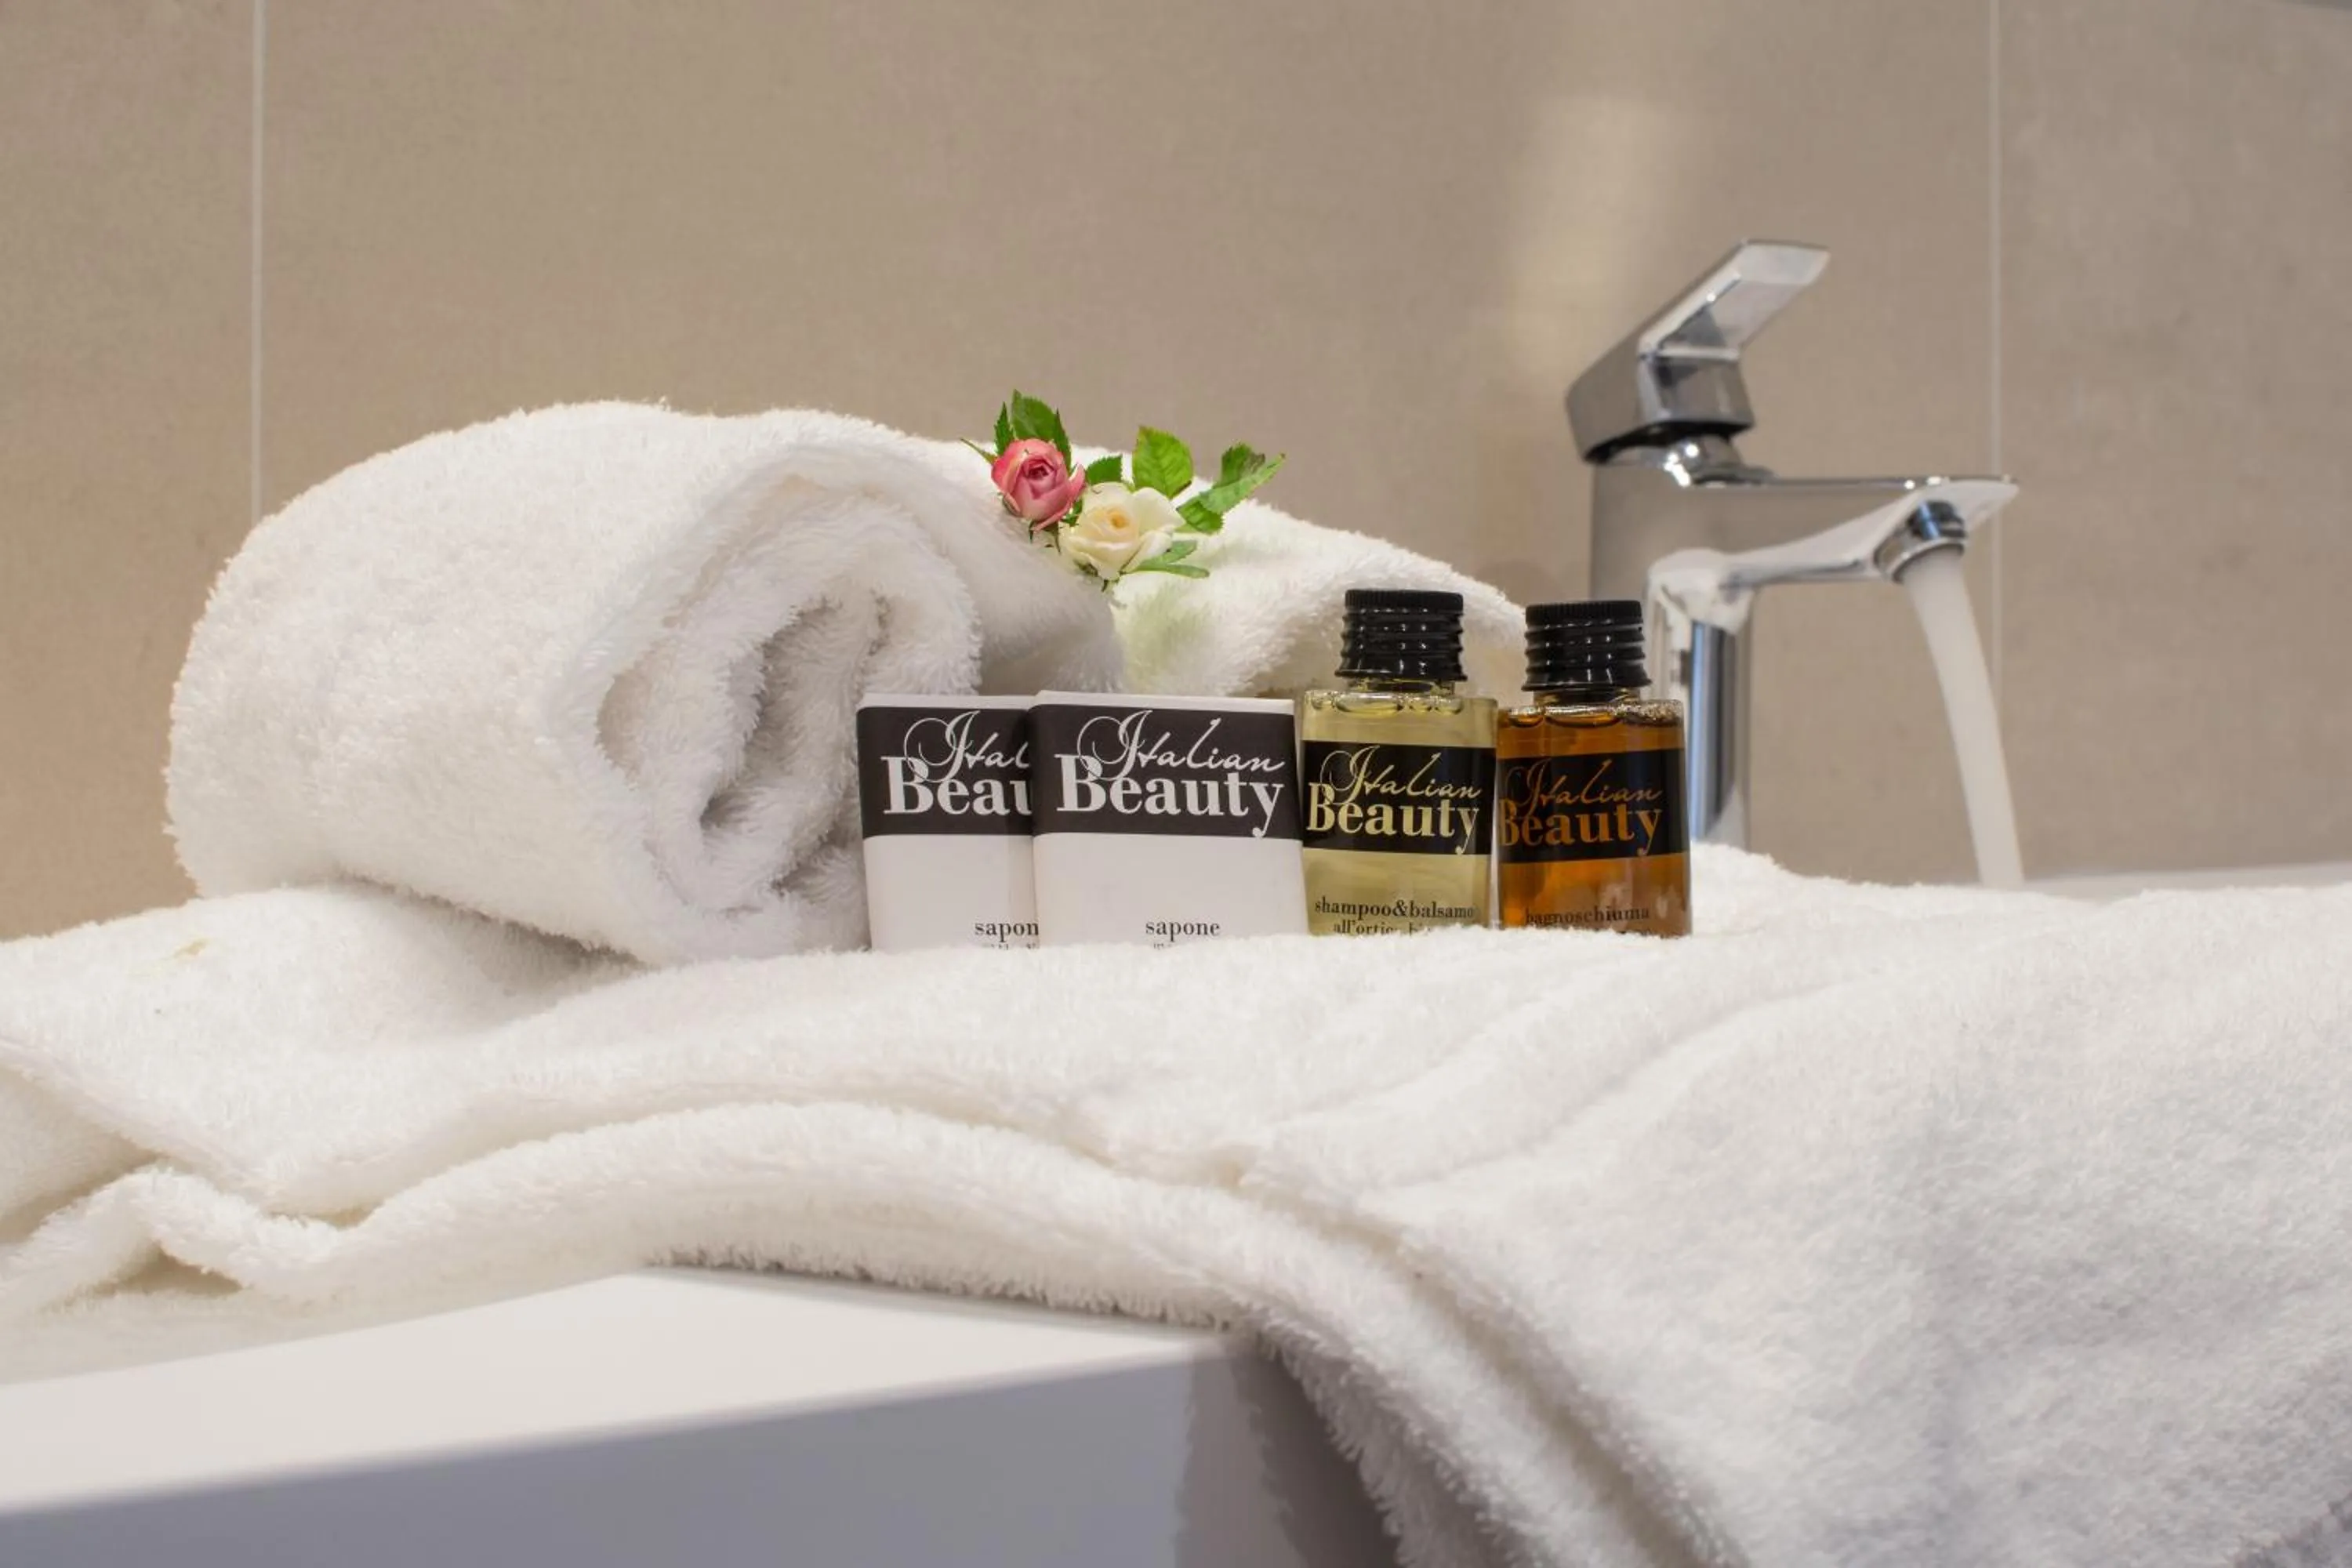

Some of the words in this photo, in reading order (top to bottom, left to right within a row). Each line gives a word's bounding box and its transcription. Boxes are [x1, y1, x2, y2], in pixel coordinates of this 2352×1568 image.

[904, 710, 1030, 782] Ital
[1077, 710, 1285, 782] Italian
[1320, 746, 1482, 804] Italian
[880, 756, 1032, 815] Beau
[1054, 753, 1284, 837] Beauty
[1504, 758, 1663, 820] Italian
[1306, 782, 1479, 855] Beauty
[1497, 798, 1663, 856] Beauty
[975, 921, 1039, 942] sapon
[1145, 920, 1220, 942] sapone
[1315, 896, 1474, 920] shampoo&balsamo
[1525, 906, 1650, 926] bagnoschiuma
